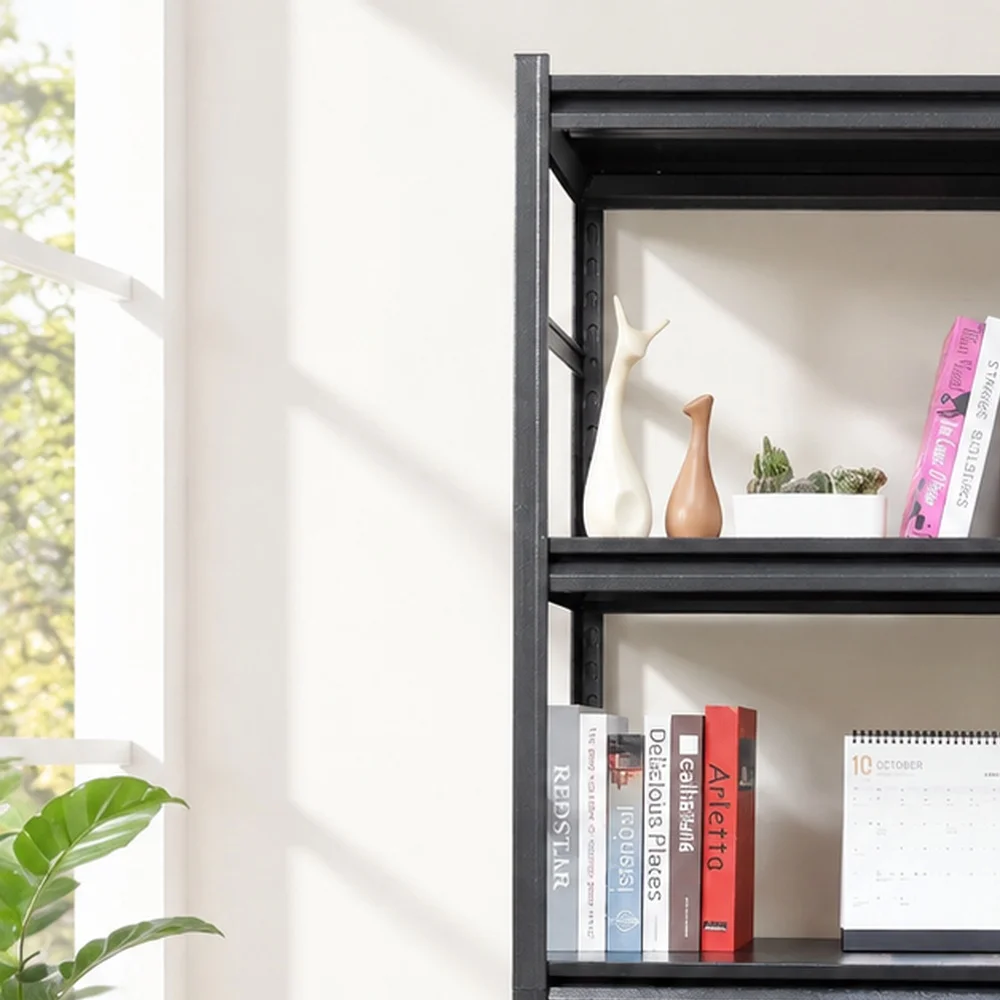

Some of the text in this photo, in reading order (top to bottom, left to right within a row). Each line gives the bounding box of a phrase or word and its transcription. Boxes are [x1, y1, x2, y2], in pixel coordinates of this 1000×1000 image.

[852, 755, 923, 776] 10 OCTOBER
[647, 834, 666, 902] Places
